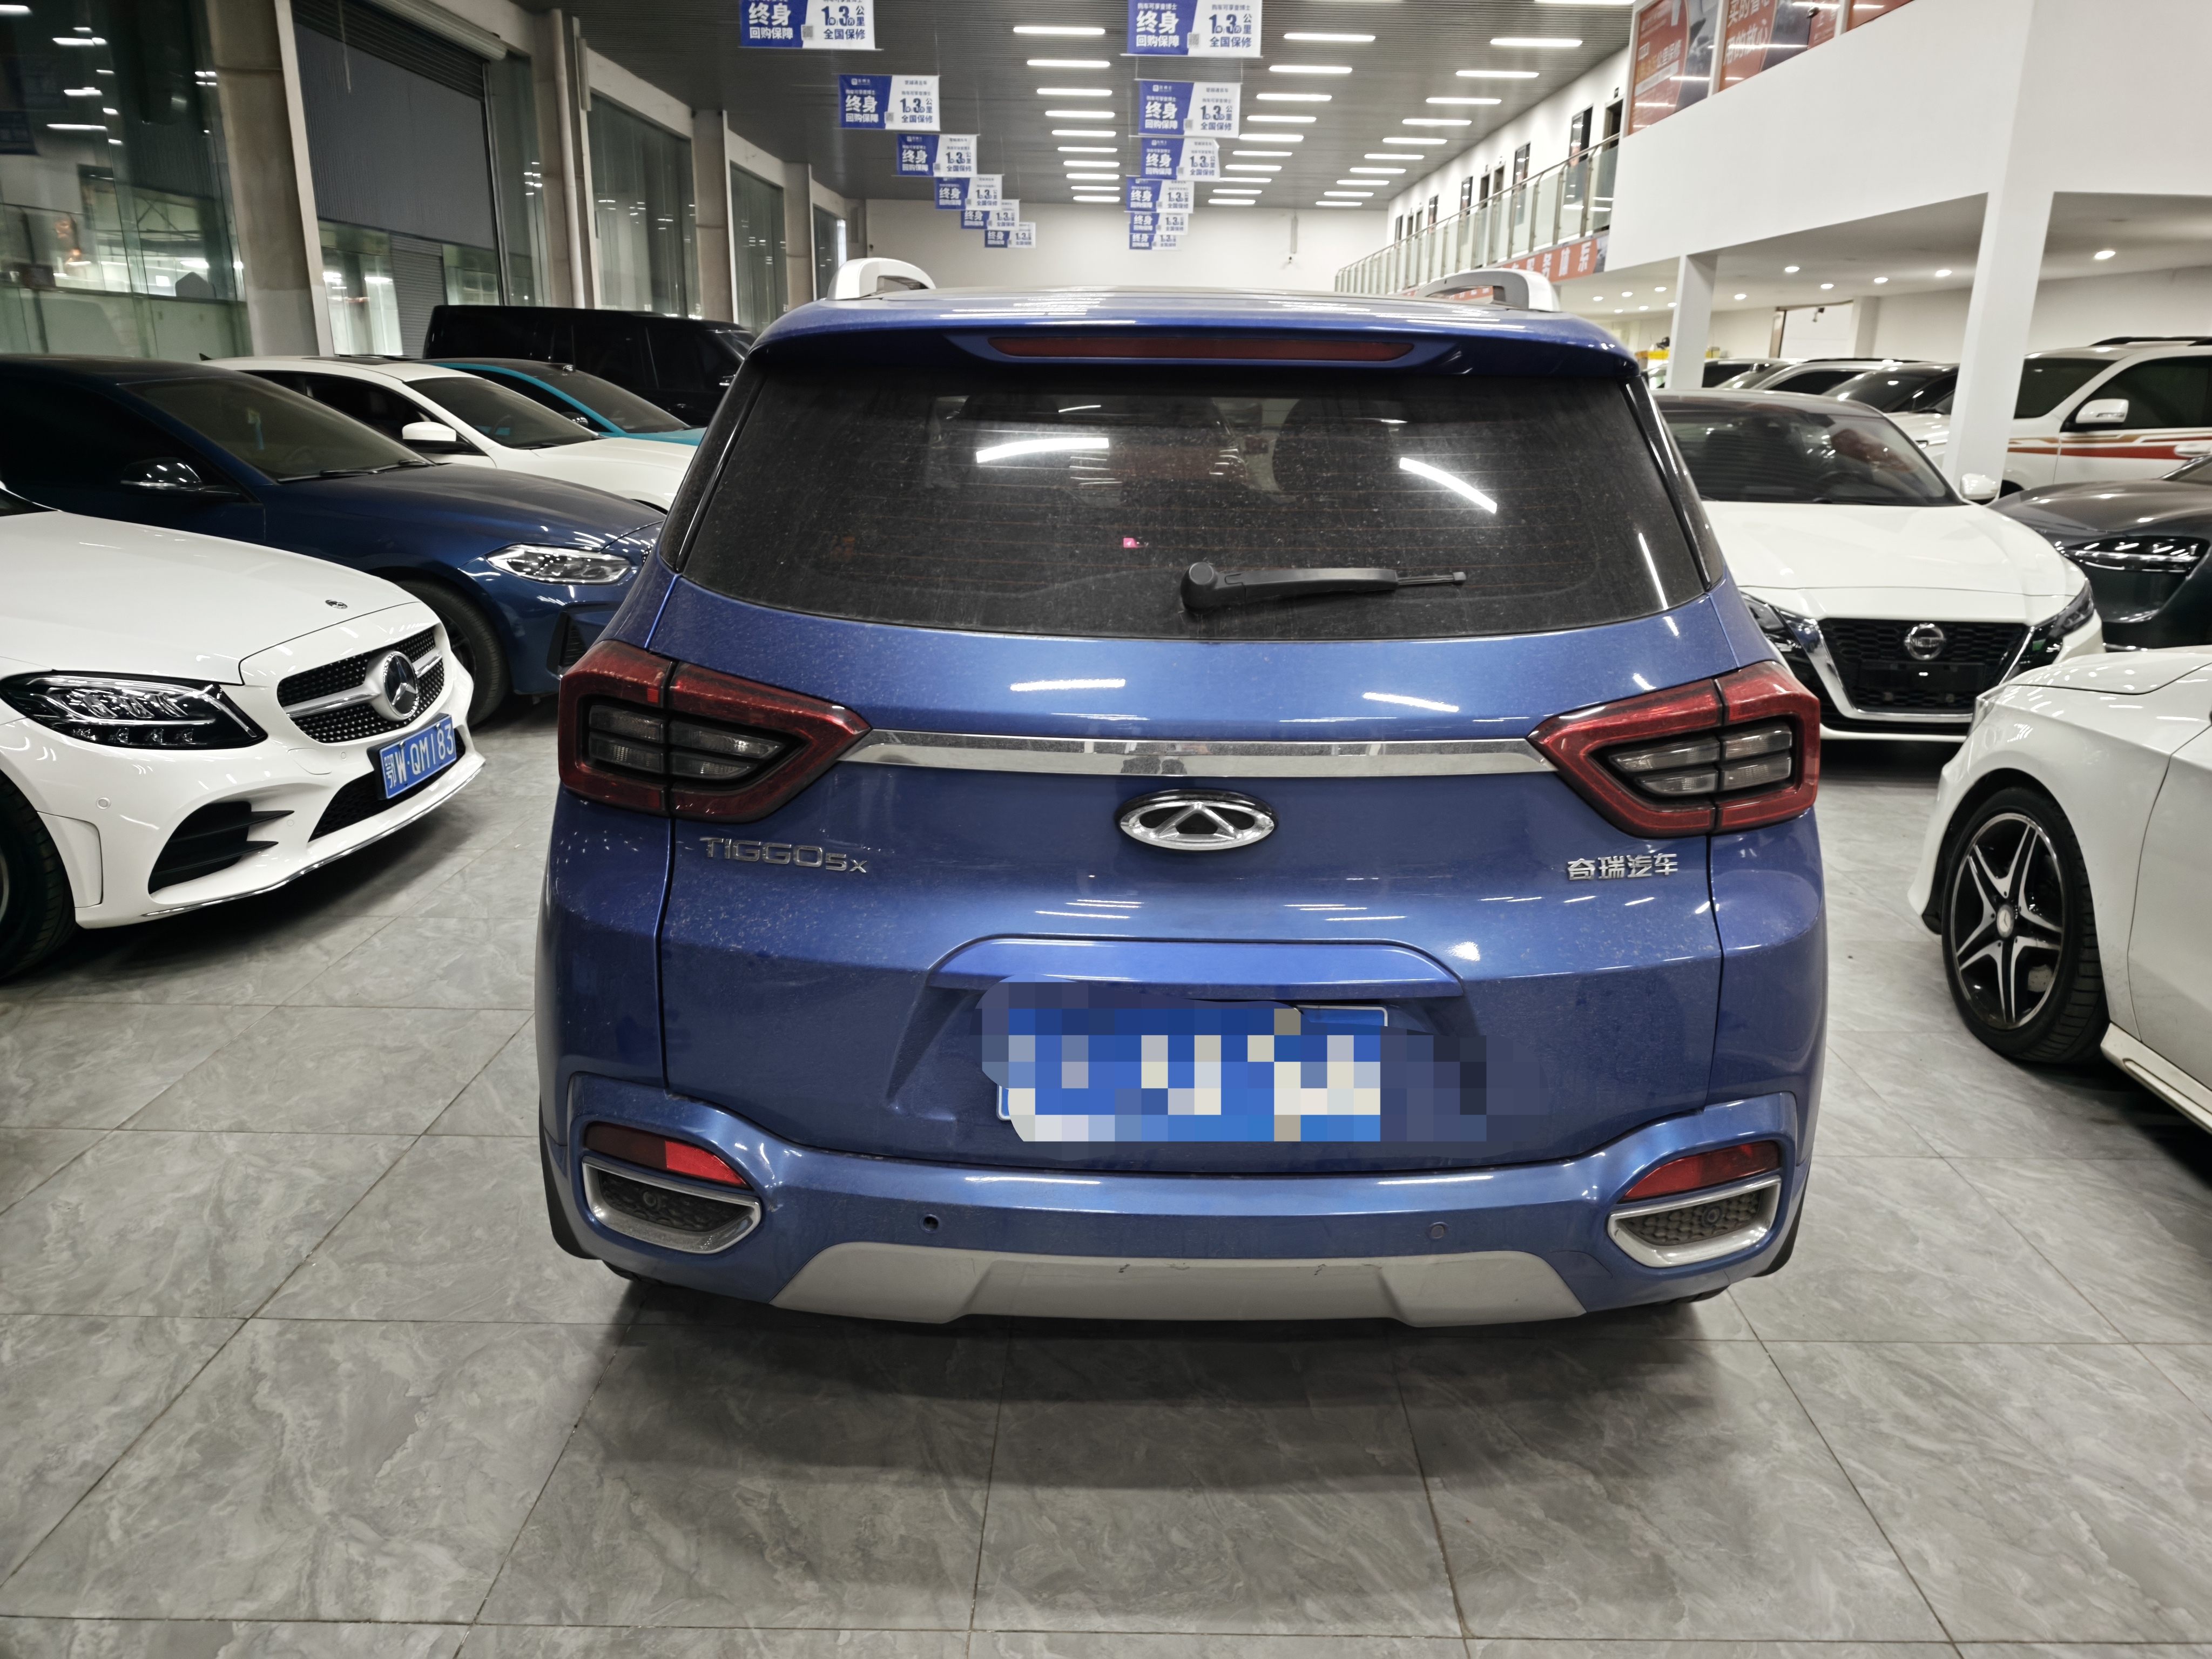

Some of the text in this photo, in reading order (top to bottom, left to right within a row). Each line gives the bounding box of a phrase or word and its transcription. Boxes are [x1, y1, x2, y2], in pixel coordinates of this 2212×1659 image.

[748, 2, 791, 26] 终身
[1136, 11, 1179, 34] 终身
[750, 26, 793, 39] 回购保障
[824, 29, 865, 40] 全国保修
[1136, 35, 1179, 48] 回购保障
[1210, 37, 1252, 48] 全国保修
[846, 95, 878, 113] 终身
[1145, 102, 1177, 119] 终身
[846, 113, 879, 123] 回购保障
[901, 114, 933, 123] 全国保修
[1145, 119, 1178, 130] 回购保障
[1201, 122, 1232, 131] 全国保修
[902, 150, 928, 164] 终身
[1145, 153, 1172, 167] 终身
[939, 187, 961, 199] 终身
[1131, 190, 1152, 201] 终身
[1568, 853, 1678, 880] 奇瑞汽车
